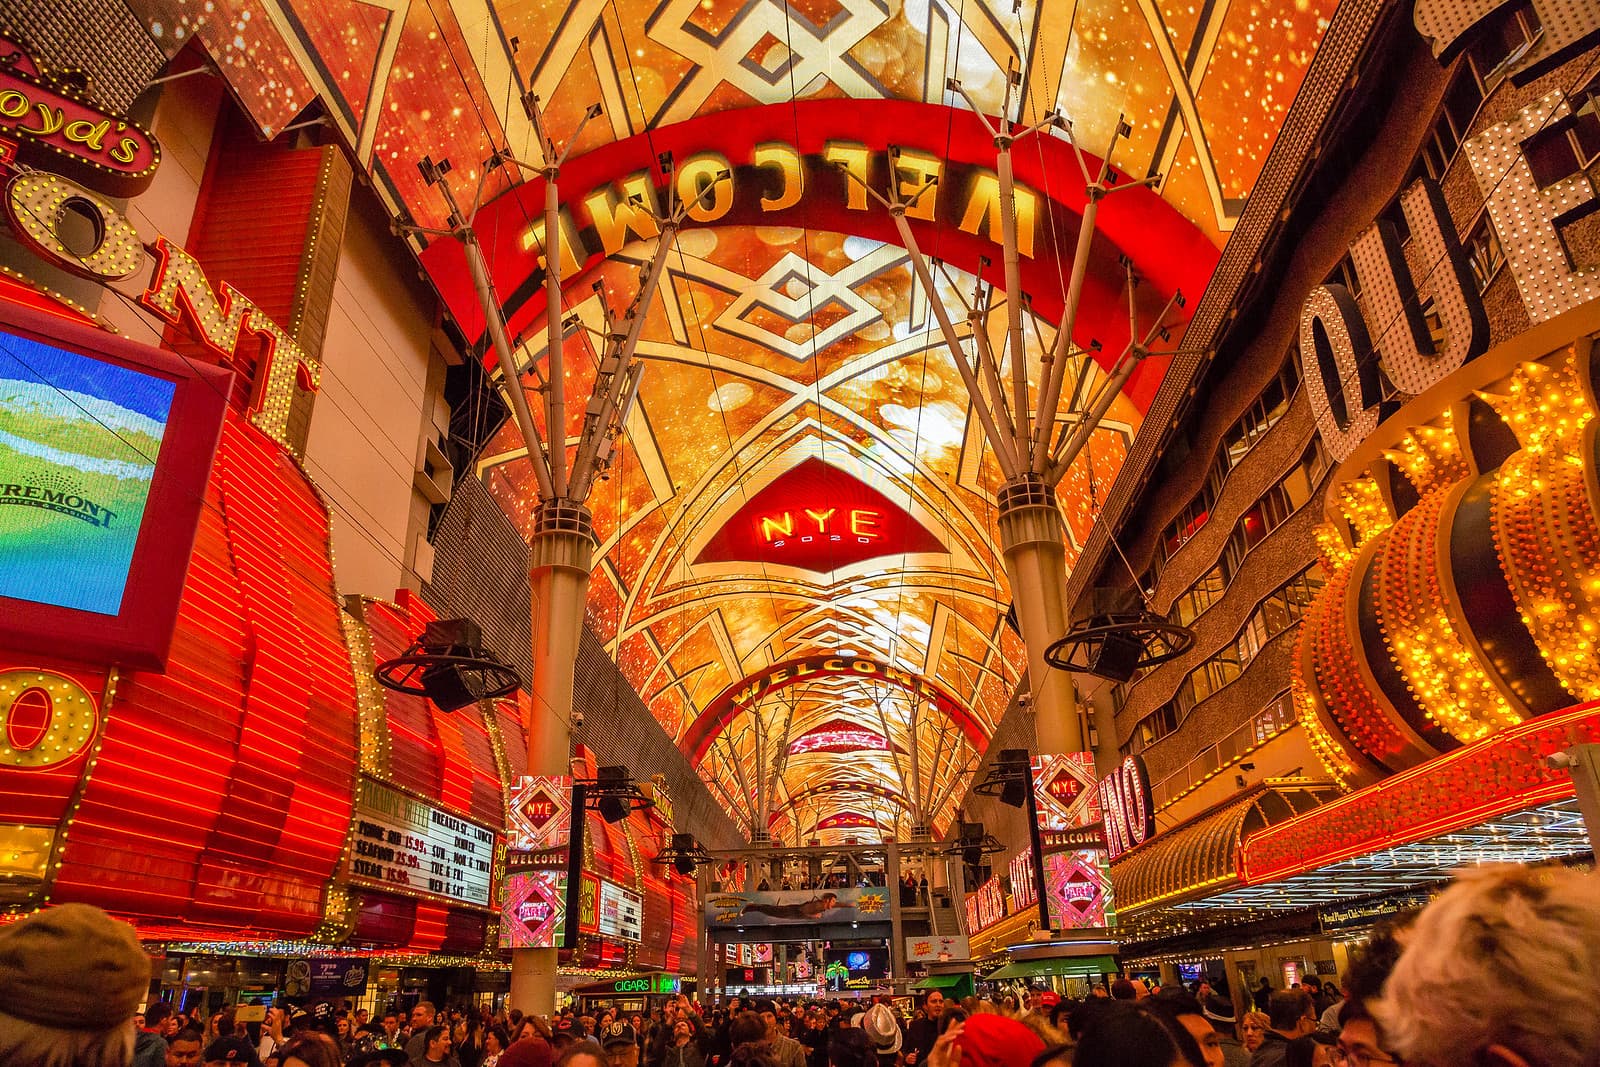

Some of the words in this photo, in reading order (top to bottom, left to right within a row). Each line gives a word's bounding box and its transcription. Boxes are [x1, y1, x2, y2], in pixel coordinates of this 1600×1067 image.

[515, 141, 1040, 287] WELCOME
[0, 140, 322, 456] ONT
[0, 484, 117, 528] REMONT
[762, 508, 879, 541] NYE
[731, 659, 937, 704] WELCOME
[1052, 781, 1078, 793] NYE
[527, 803, 552, 814] NYE
[1045, 833, 1101, 845] WELCOME
[354, 858, 383, 879] STEAK
[510, 853, 565, 865] WELCOME
[431, 861, 444, 876] TUE
[453, 868, 464, 882] FRI
[429, 878, 443, 893] WED
[453, 883, 464, 898] SAT
[1063, 885, 1096, 901] PARTY
[519, 905, 550, 919] PARTY
[614, 979, 650, 992] CIGARS
